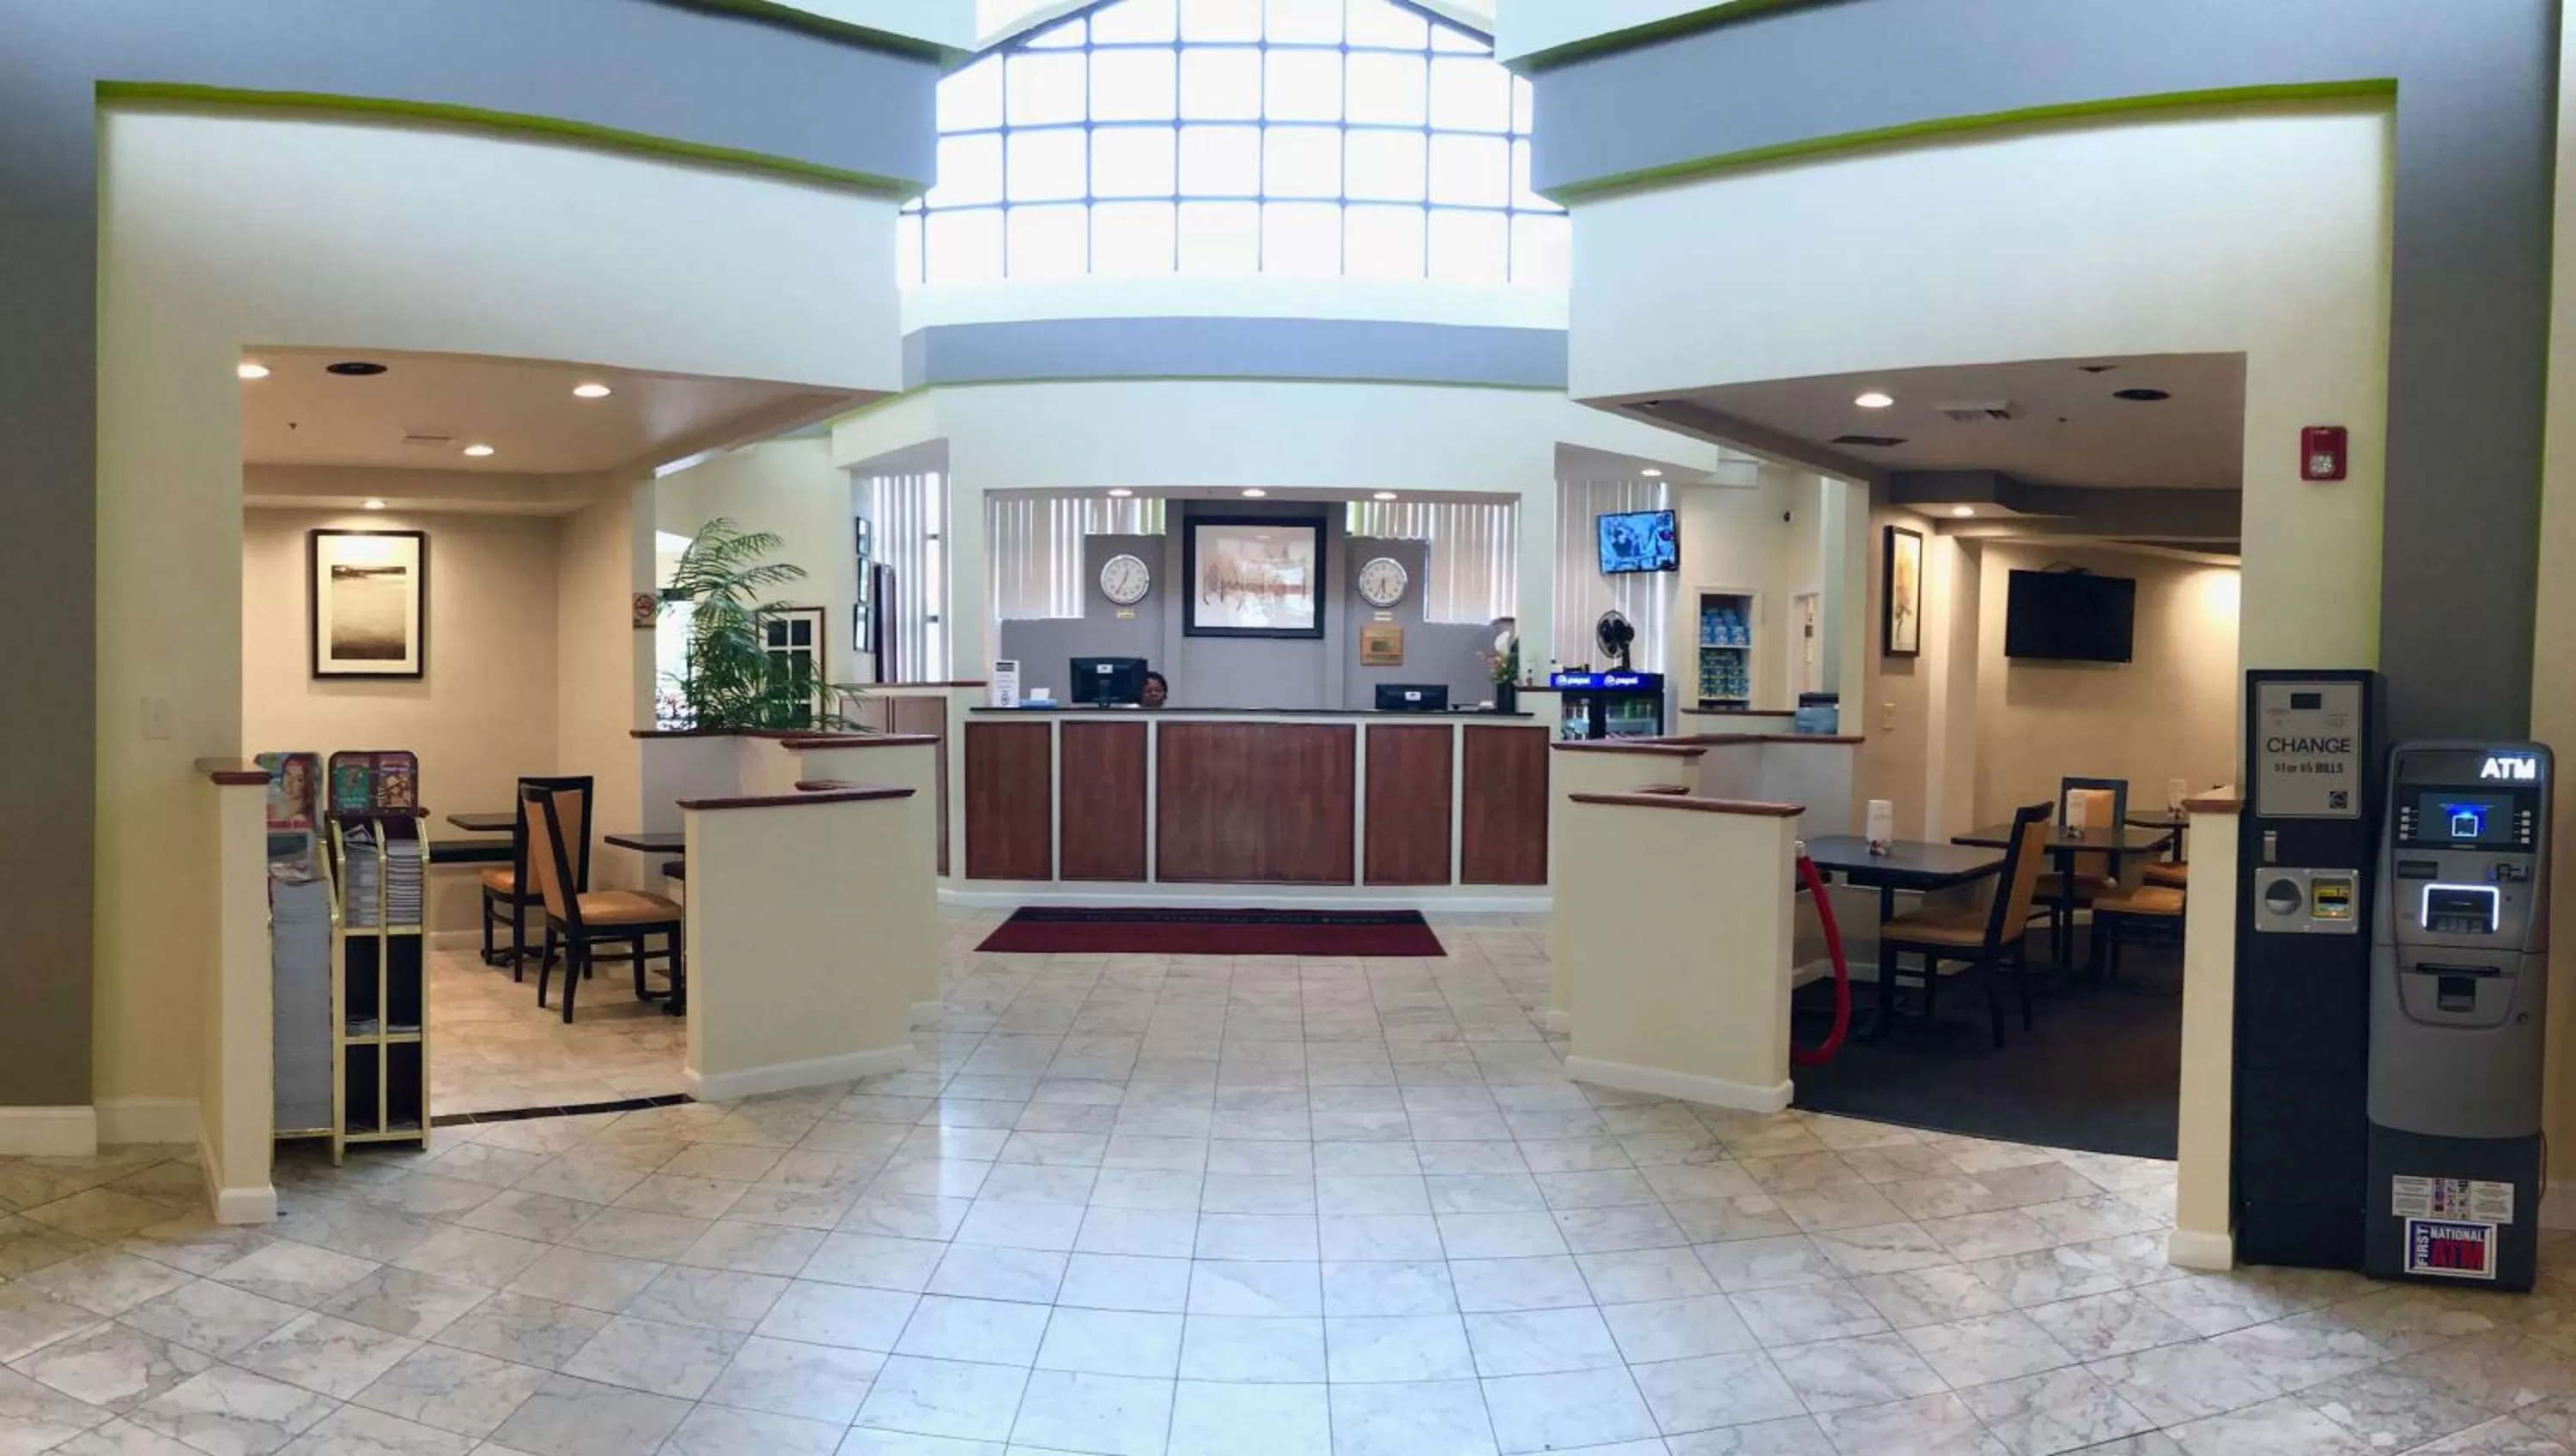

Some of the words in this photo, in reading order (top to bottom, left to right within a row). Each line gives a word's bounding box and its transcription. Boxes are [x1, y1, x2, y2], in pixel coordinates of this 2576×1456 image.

[2266, 737, 2351, 754] CHANGE
[2480, 756, 2537, 780] ATM
[2417, 1225, 2429, 1266] FIRST
[2430, 1226, 2484, 1241] NATIONAL
[2431, 1239, 2484, 1270] ATM
